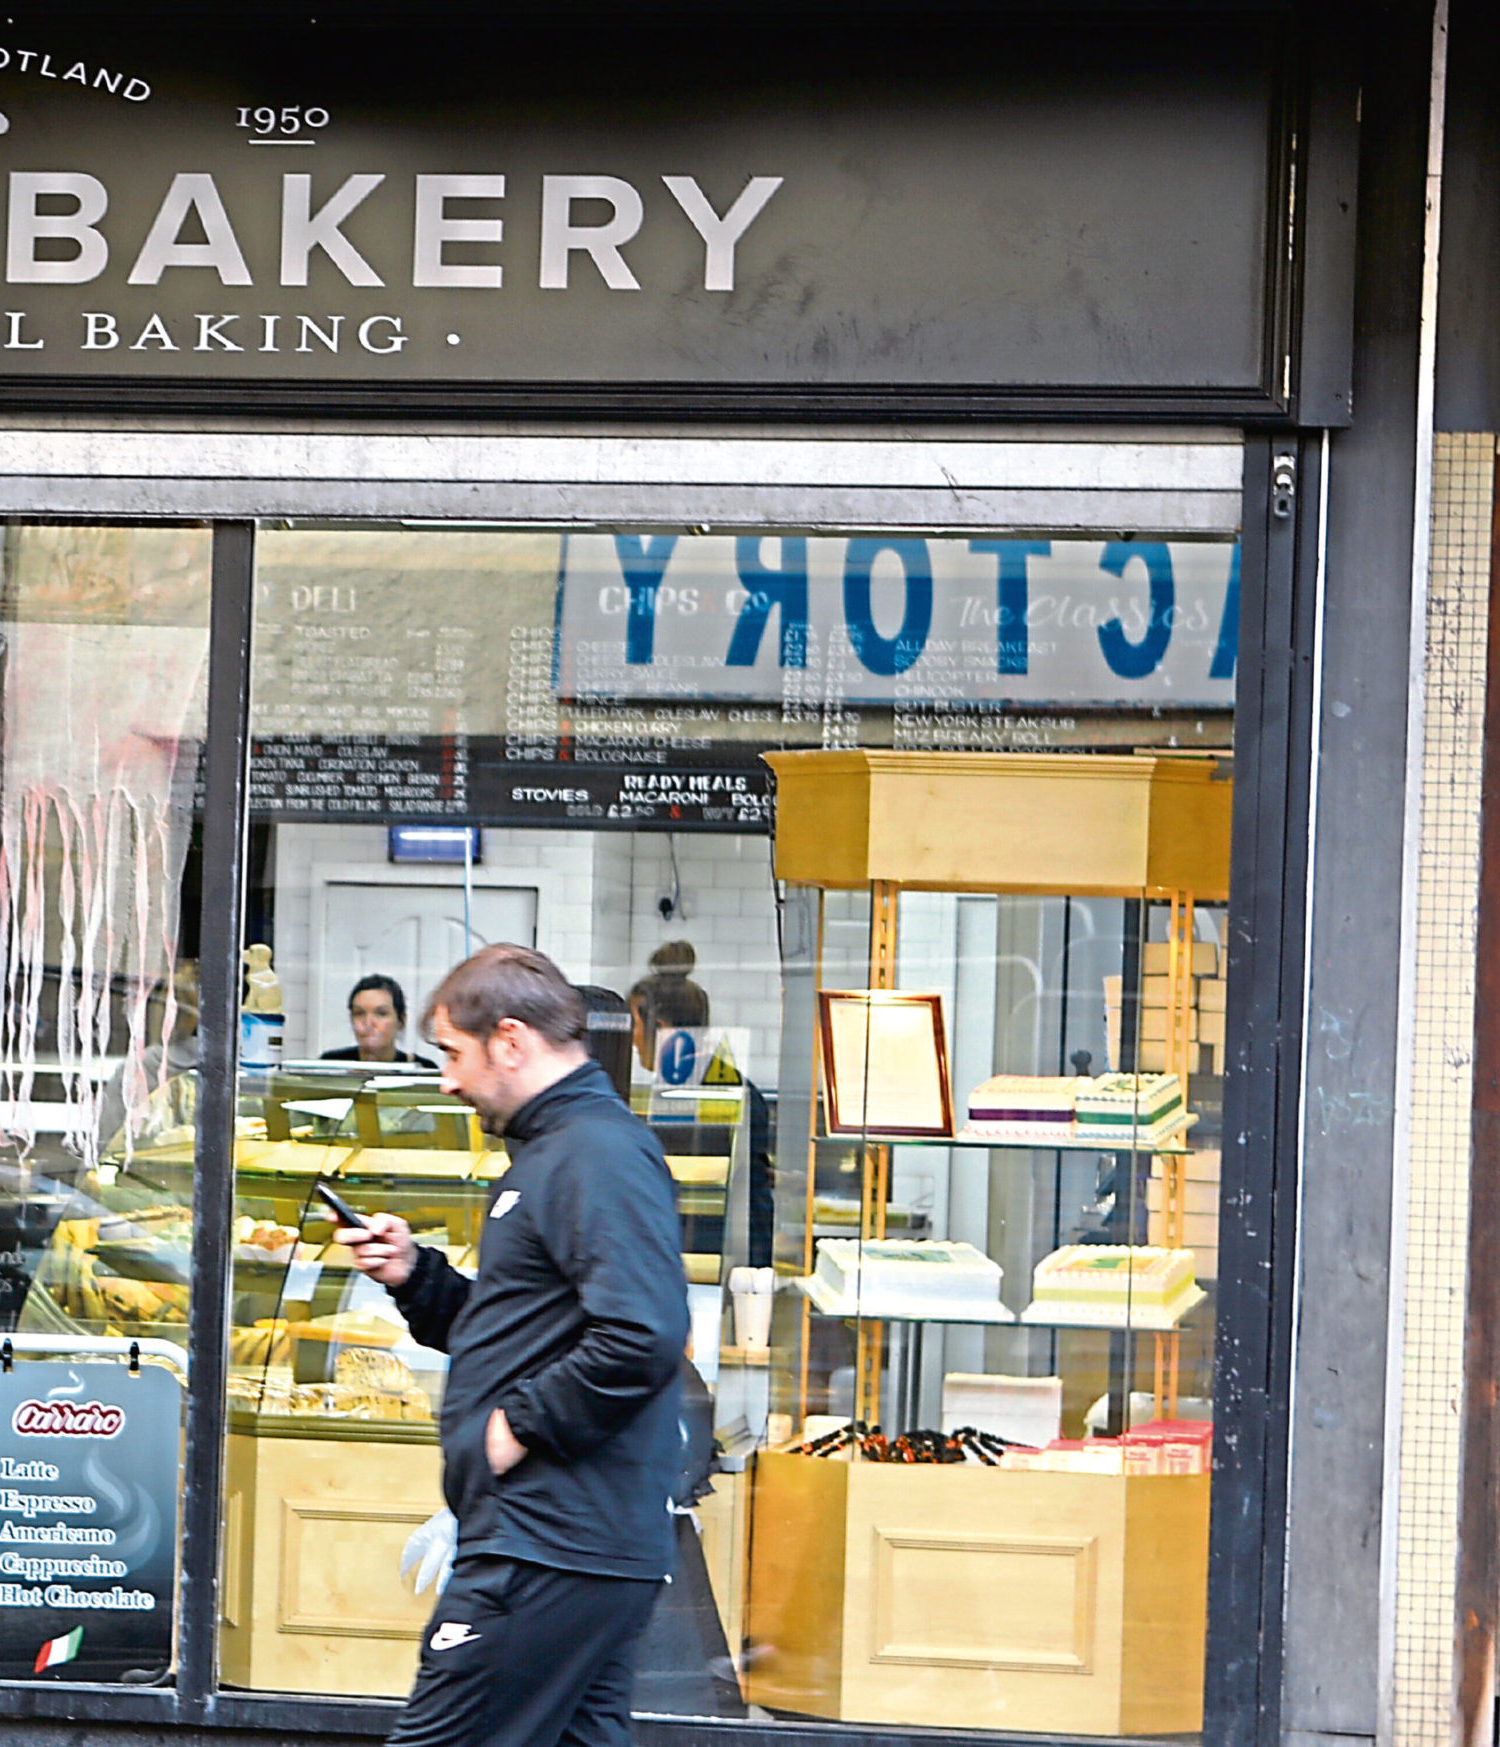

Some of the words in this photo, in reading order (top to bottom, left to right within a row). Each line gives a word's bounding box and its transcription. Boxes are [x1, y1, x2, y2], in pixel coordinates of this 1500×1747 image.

[235, 105, 330, 135] 1950
[4, 171, 785, 291] BAKERY
[81, 313, 409, 355] BAKING
[292, 585, 357, 612] DELI
[598, 586, 700, 617] CHIPS
[1022, 594, 1210, 633] Classics
[293, 625, 372, 640] TOASTED
[895, 671, 999, 685] HELICOPTER
[894, 685, 966, 699] CHINOOK
[574, 720, 633, 734] CHICKEN
[504, 747, 556, 761] CHIPS
[623, 774, 683, 791] READY
[688, 775, 748, 792] MEALS
[511, 788, 590, 803] STOVIES
[618, 791, 709, 805] MACARONI
[13, 1400, 124, 1437] Carraro
[1, 1458, 59, 1481] Latte
[0, 1490, 96, 1515] Espresso
[0, 1552, 127, 1580] Cappuccino
[46, 1586, 155, 1610] Chocolate
